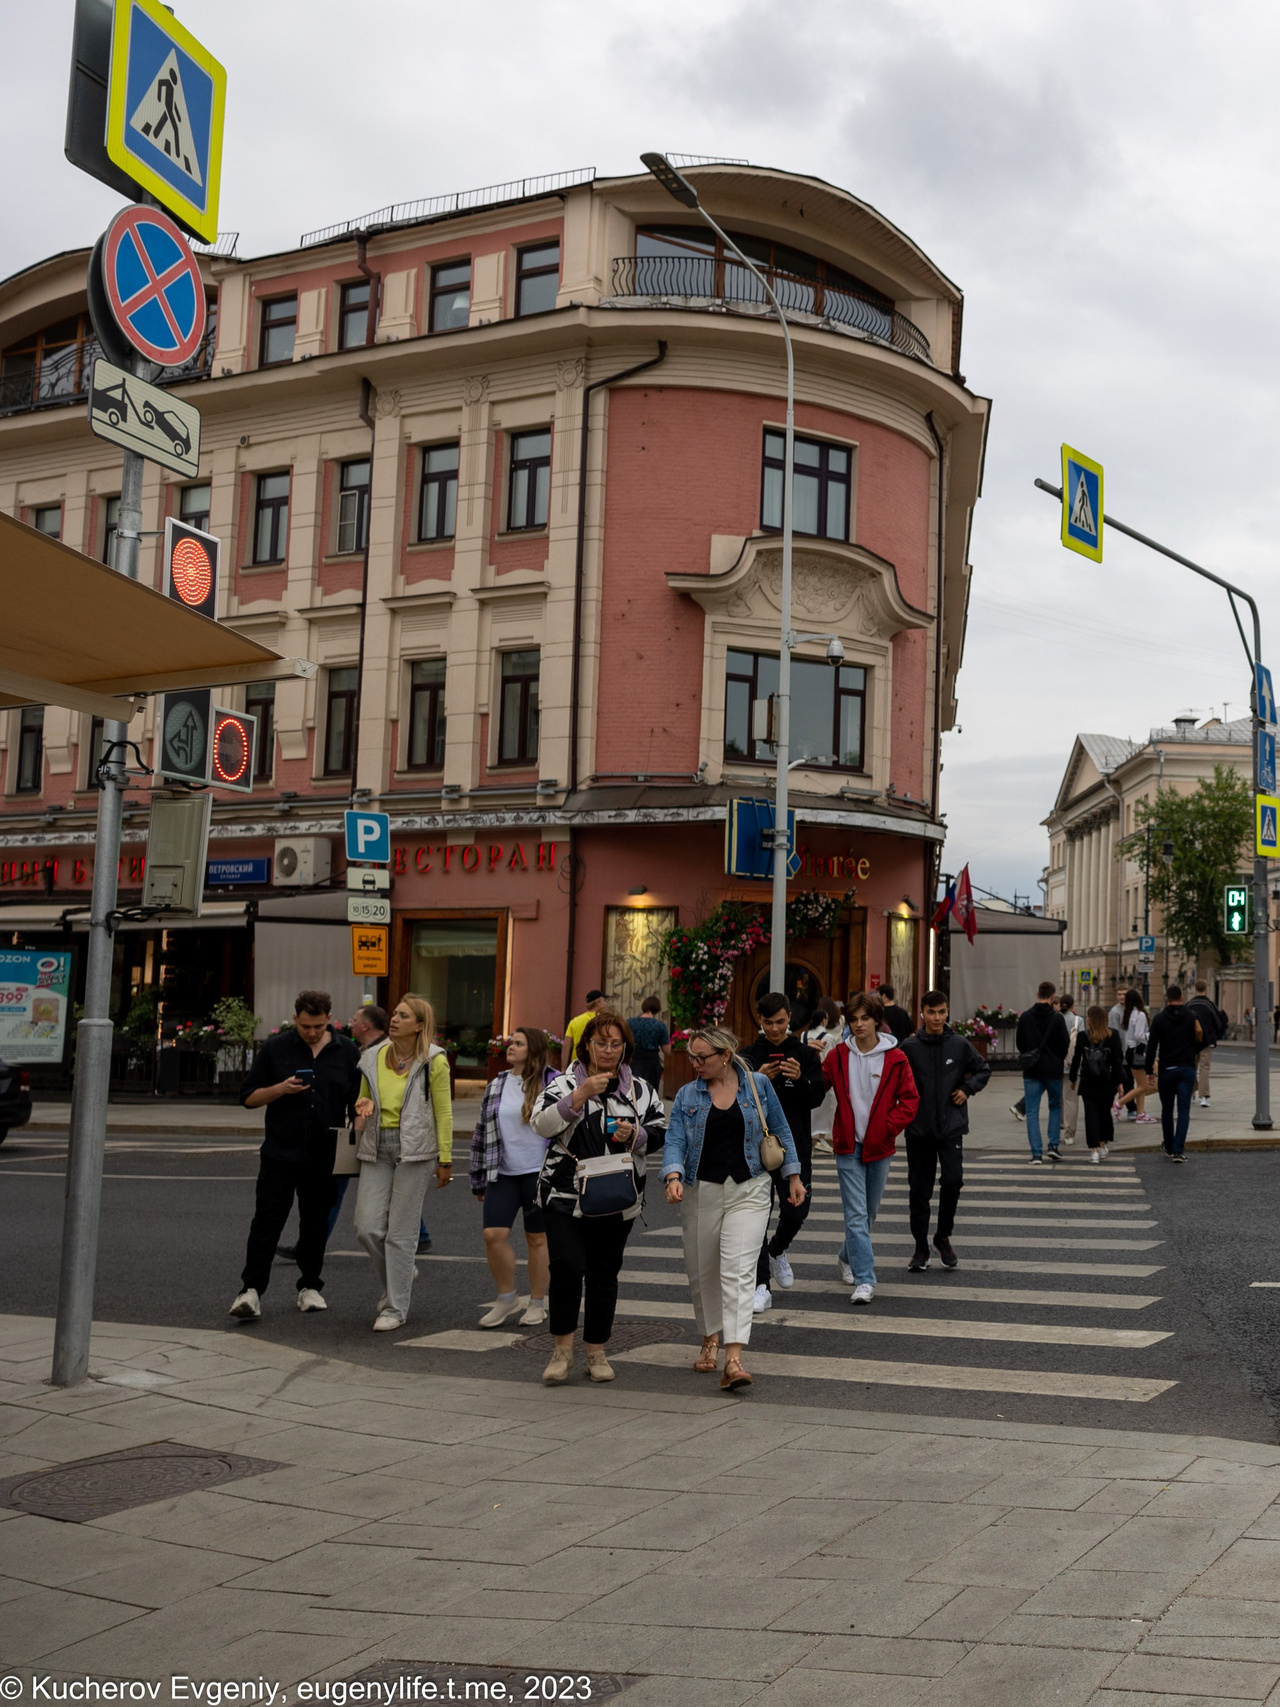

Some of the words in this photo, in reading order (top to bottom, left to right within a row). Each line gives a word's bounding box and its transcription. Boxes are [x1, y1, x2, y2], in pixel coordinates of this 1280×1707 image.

[357, 819, 381, 853] P
[374, 842, 557, 875] ЕСТОРАН
[208, 862, 253, 874] ПЕТРОВСКИЙ
[1228, 890, 1245, 906] 04
[352, 905, 360, 915] 10
[361, 904, 371, 916] 15
[372, 904, 386, 917] 20
